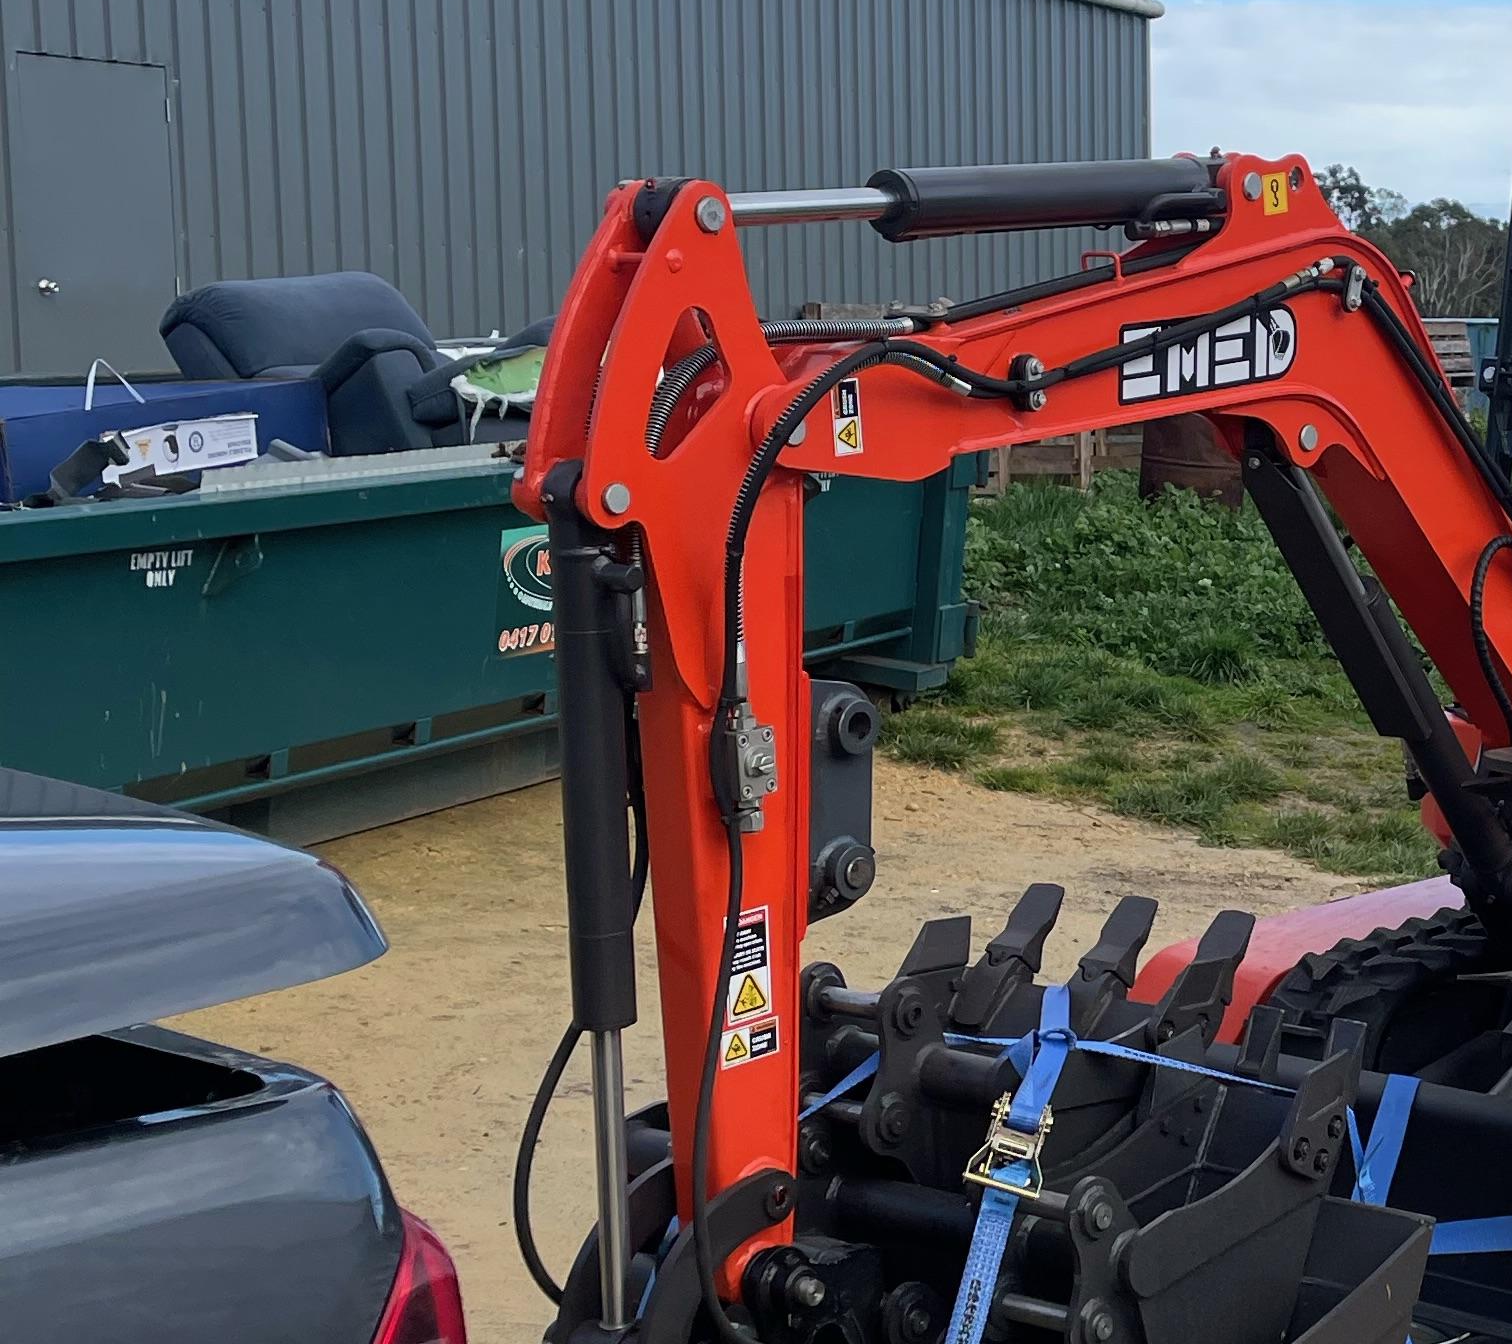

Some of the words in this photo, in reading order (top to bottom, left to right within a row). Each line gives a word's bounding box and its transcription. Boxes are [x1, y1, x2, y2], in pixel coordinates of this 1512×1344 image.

[130, 551, 169, 571] EMPTY
[170, 549, 194, 568] LIFT
[145, 569, 176, 587] ONLY
[499, 624, 539, 652] 0417
